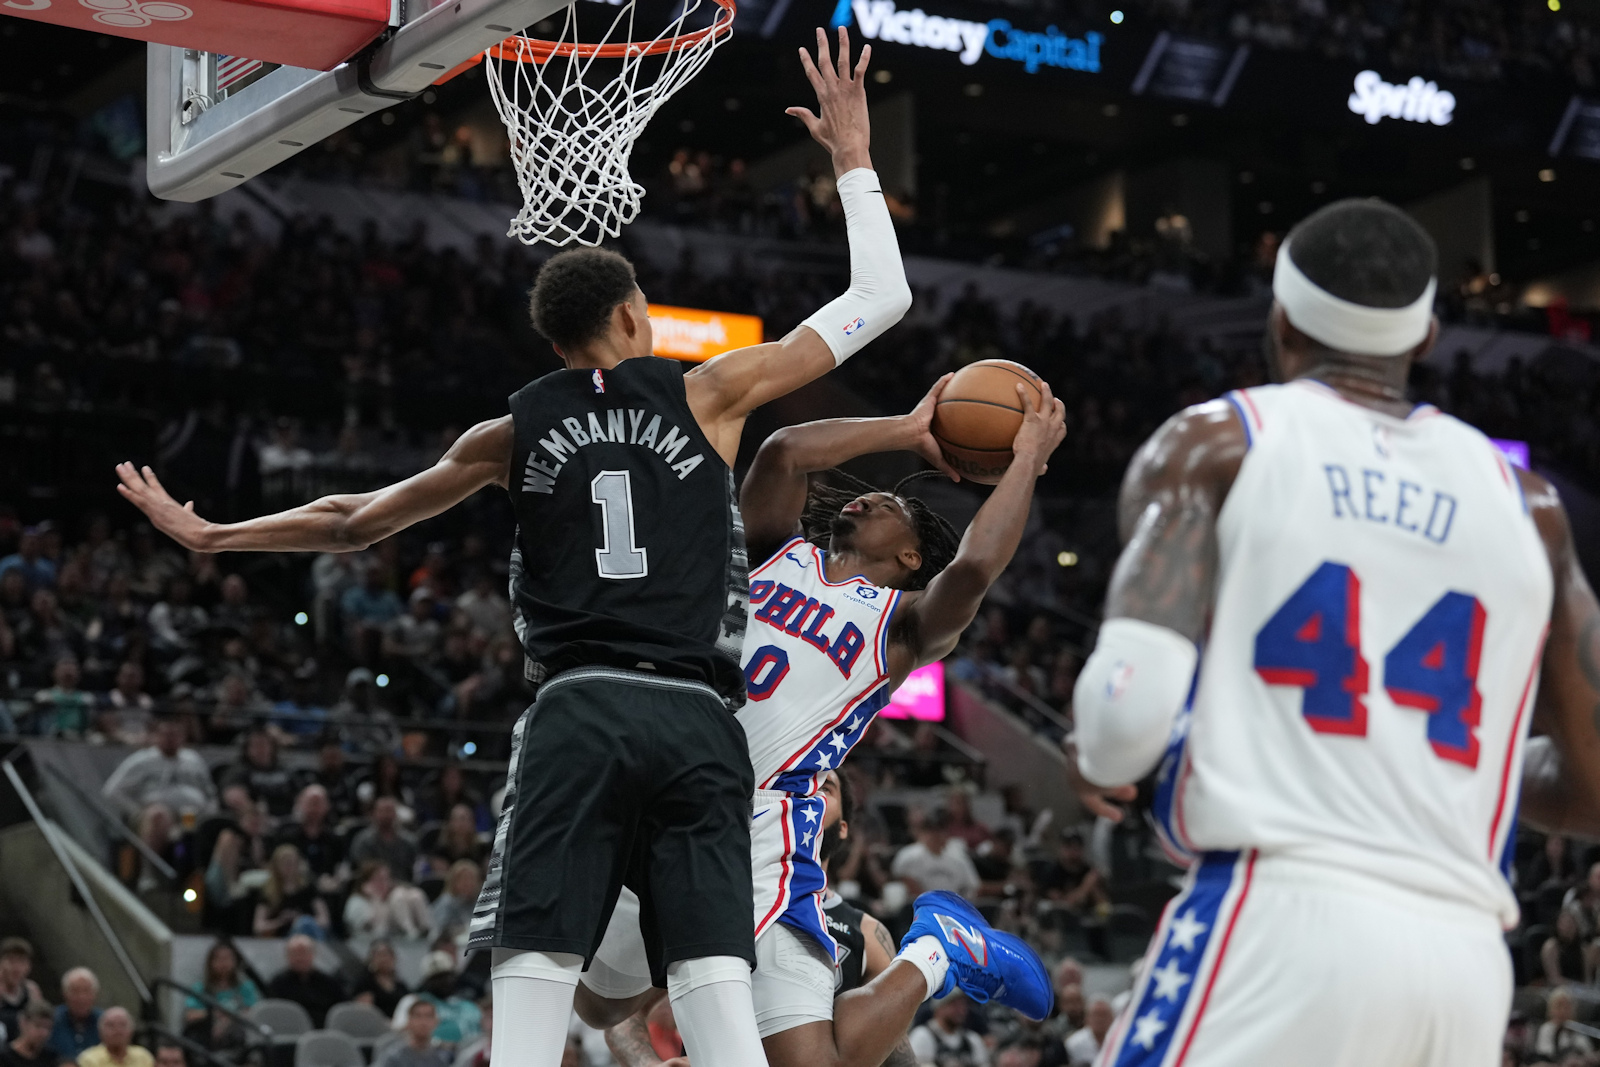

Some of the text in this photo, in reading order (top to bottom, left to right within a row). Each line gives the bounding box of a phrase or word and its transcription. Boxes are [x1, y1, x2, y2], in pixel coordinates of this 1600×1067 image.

[1348, 69, 1456, 126] Sprite
[522, 408, 705, 495] WEMBANYAMA
[591, 470, 649, 579] 1
[1322, 464, 1457, 545] REED
[843, 592, 882, 613] crypto.com
[744, 644, 791, 702] 0
[1253, 560, 1488, 772] 44
